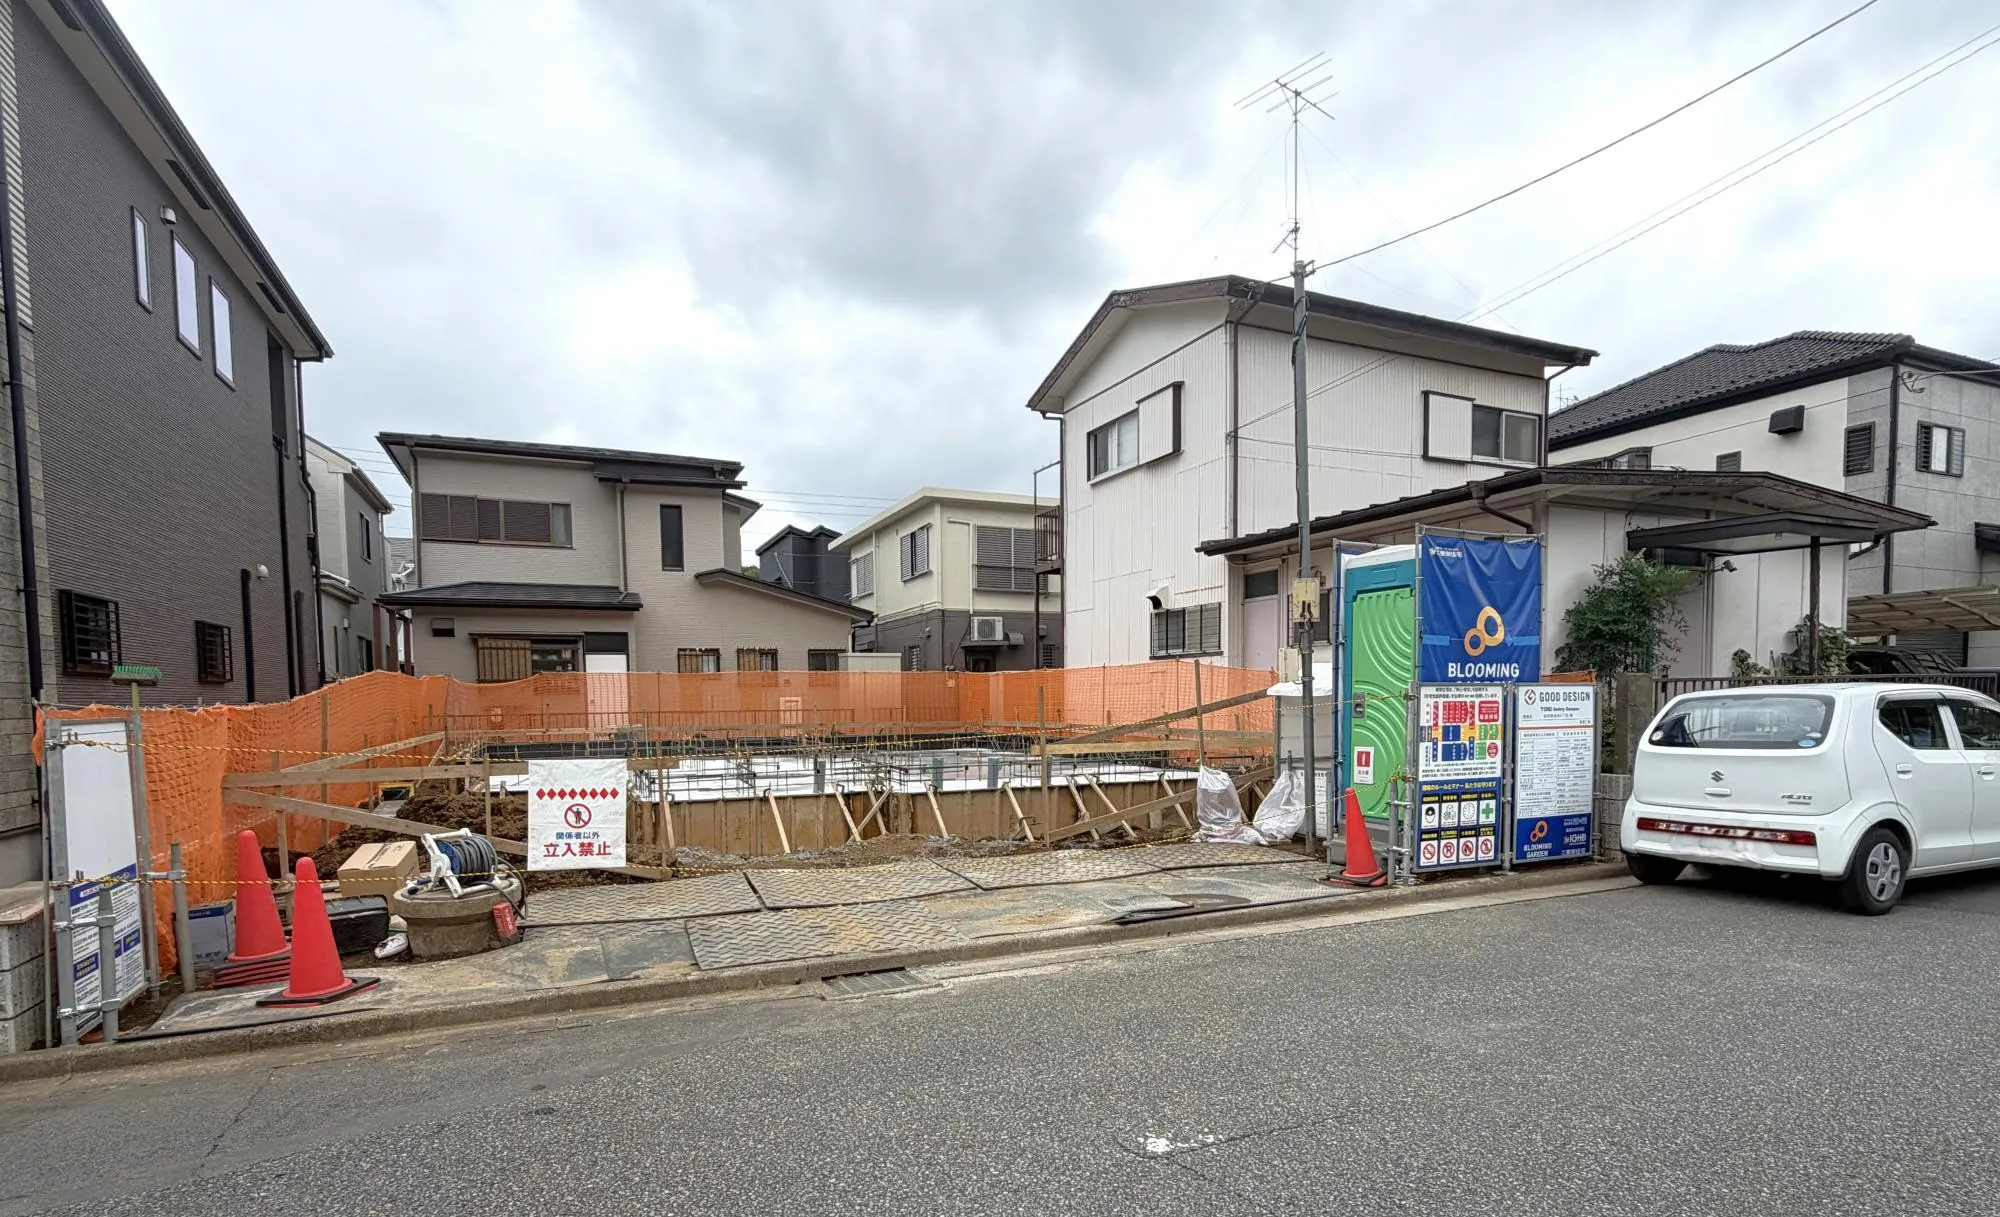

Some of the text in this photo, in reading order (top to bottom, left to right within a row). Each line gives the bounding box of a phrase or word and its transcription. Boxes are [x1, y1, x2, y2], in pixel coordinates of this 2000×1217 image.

[1447, 662, 1520, 678] BLOOMING
[1539, 691, 1591, 702] GOOD DESIGN
[555, 831, 600, 840] 関係者以外
[543, 841, 612, 858] 立入禁止
[1523, 843, 1553, 851] BLOOMING
[1526, 850, 1549, 858] GARDEN
